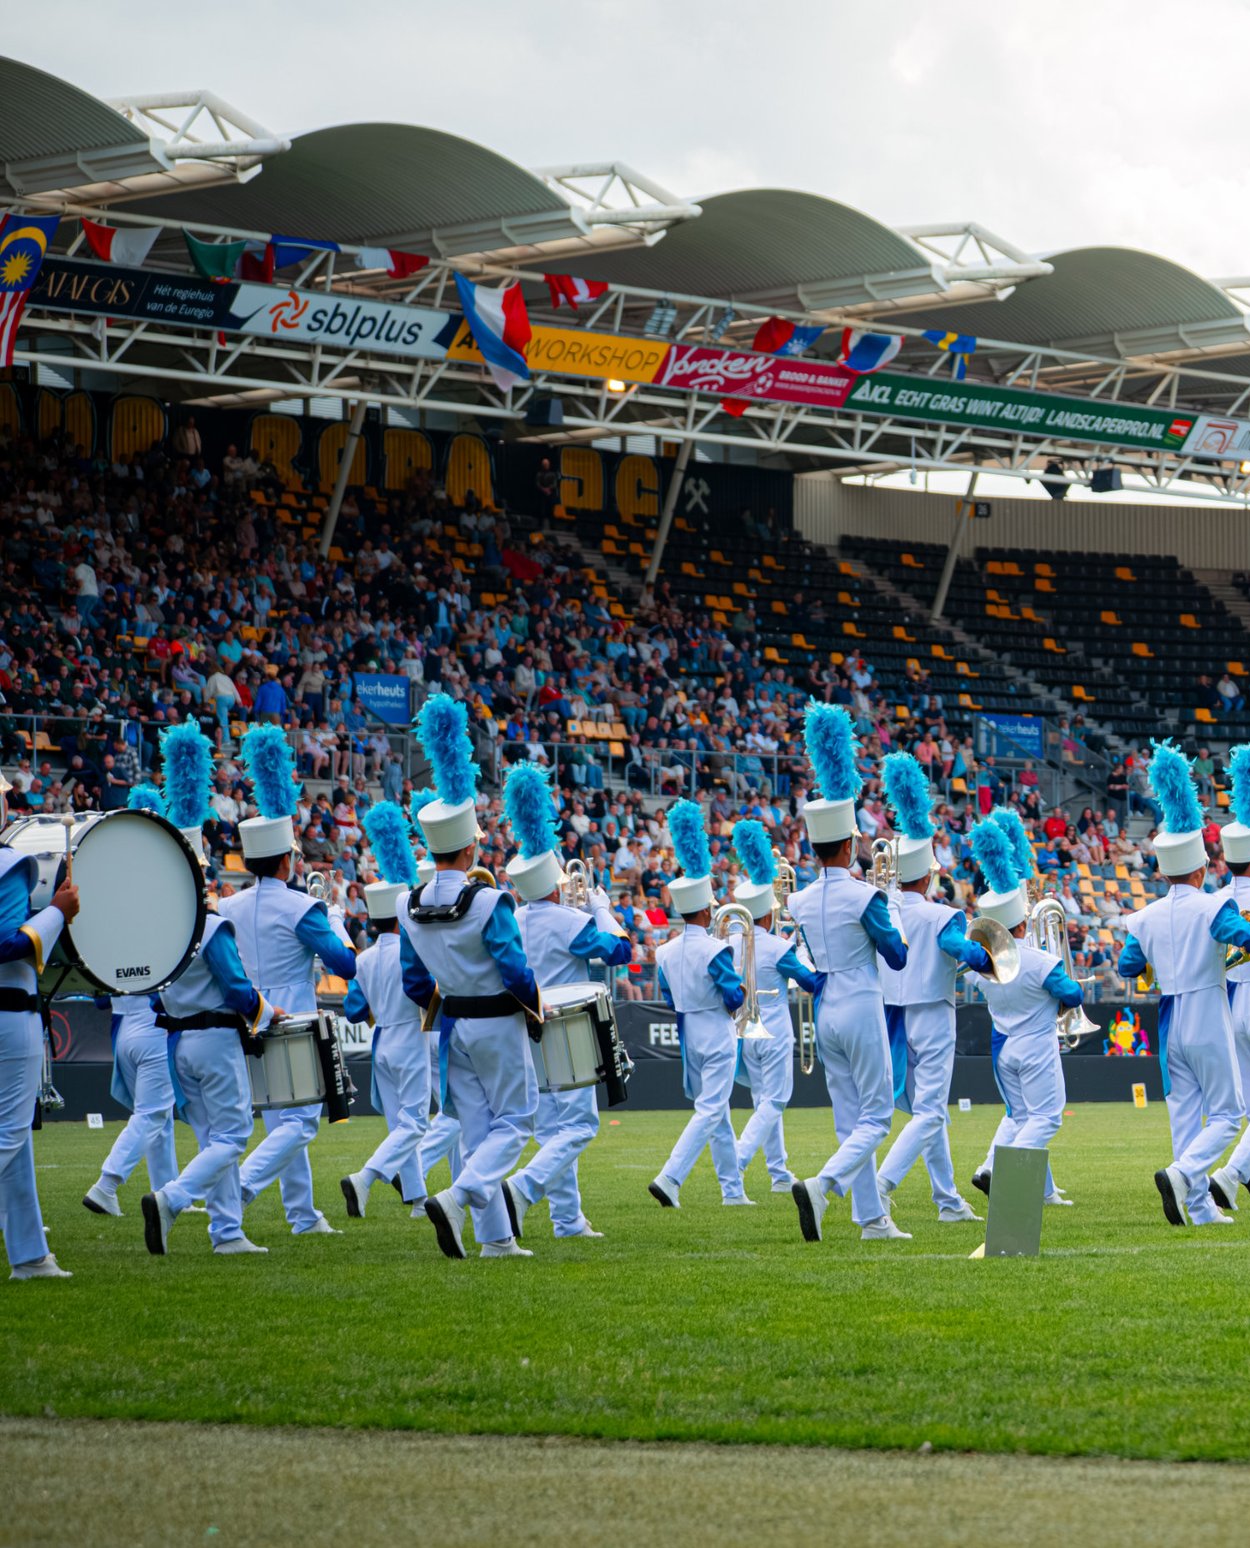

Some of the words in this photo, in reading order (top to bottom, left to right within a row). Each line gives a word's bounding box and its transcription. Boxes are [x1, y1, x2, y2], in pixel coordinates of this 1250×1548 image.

[173, 287, 215, 302] regiehuis
[147, 302, 164, 312] van
[165, 301, 178, 313] de
[178, 305, 214, 319] Euregio
[306, 302, 423, 346] sblplus
[525, 338, 660, 371] WORKSHOP
[869, 384, 893, 404] ICL
[894, 389, 932, 408] ECHT
[928, 394, 967, 413] GRAS
[965, 398, 1003, 418] WINT
[1045, 410, 1166, 440] LANDSCAPERPRO.NL
[356, 680, 406, 698] ekerheuts
[116, 965, 151, 979] EVANS
